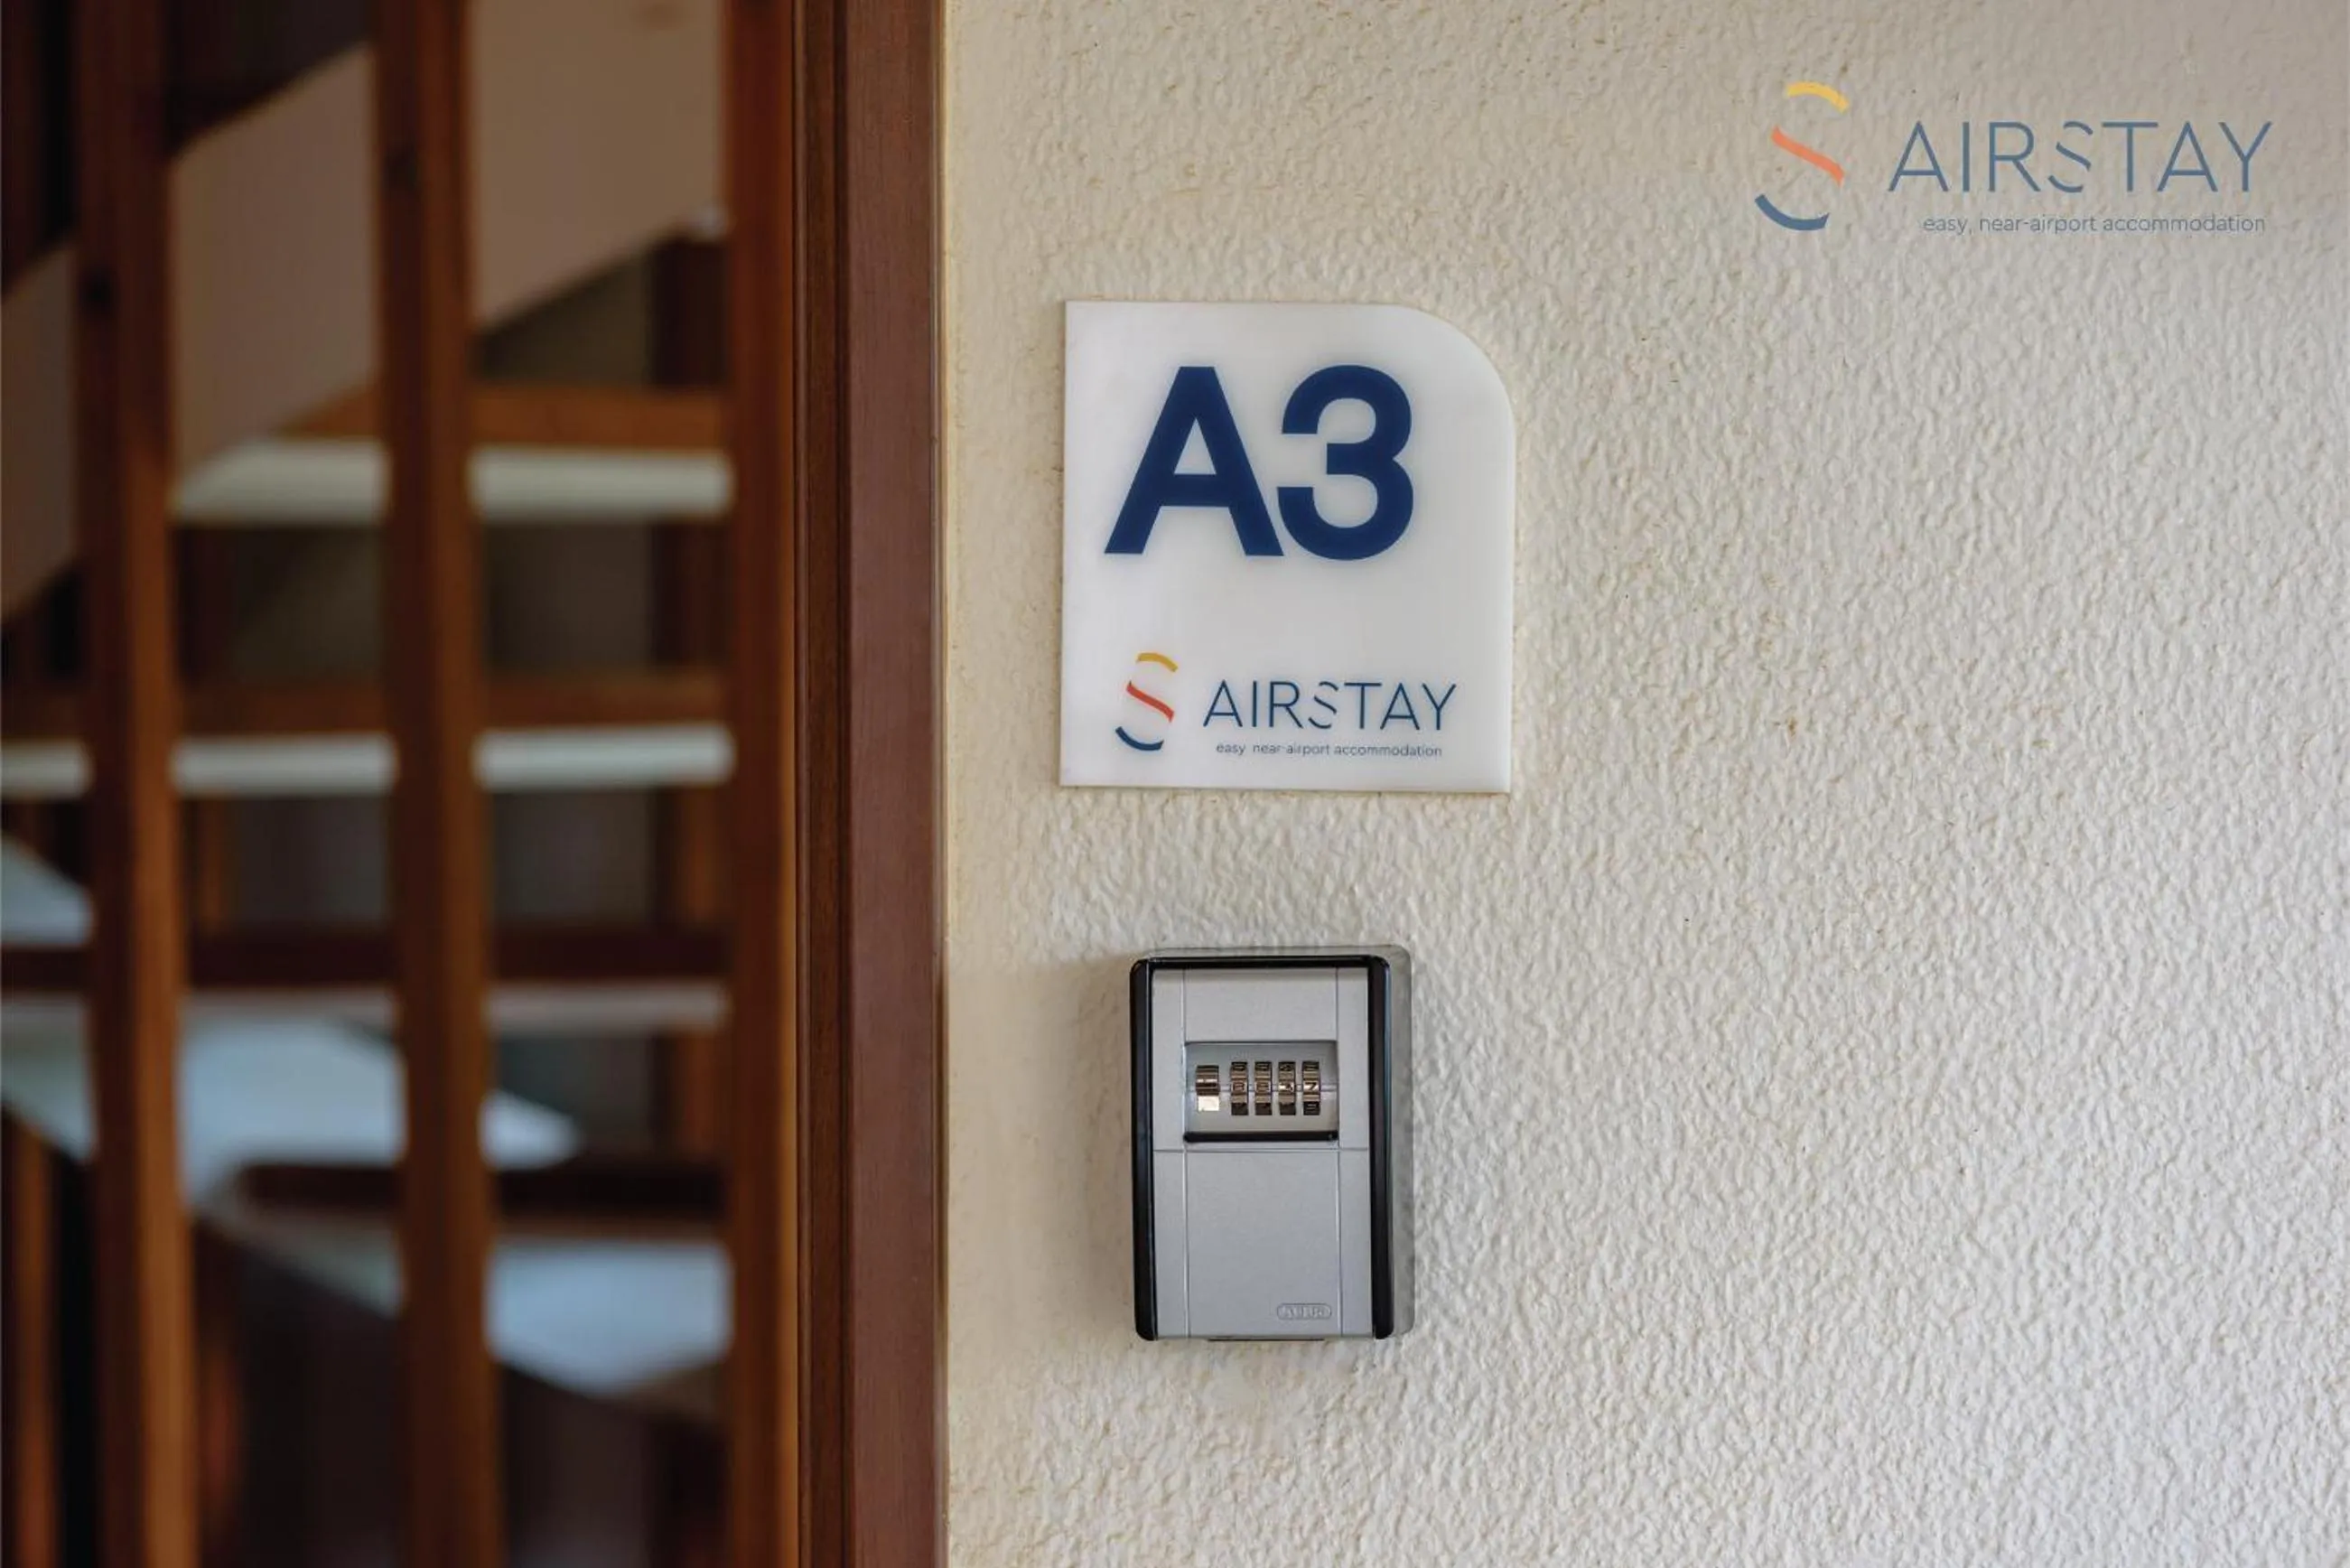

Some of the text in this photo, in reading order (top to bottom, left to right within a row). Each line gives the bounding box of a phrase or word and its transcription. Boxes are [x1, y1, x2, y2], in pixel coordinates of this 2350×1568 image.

[1104, 364, 1414, 562] A3
[1203, 679, 1457, 731] AIRSTAY
[1333, 743, 1443, 758] accommodation
